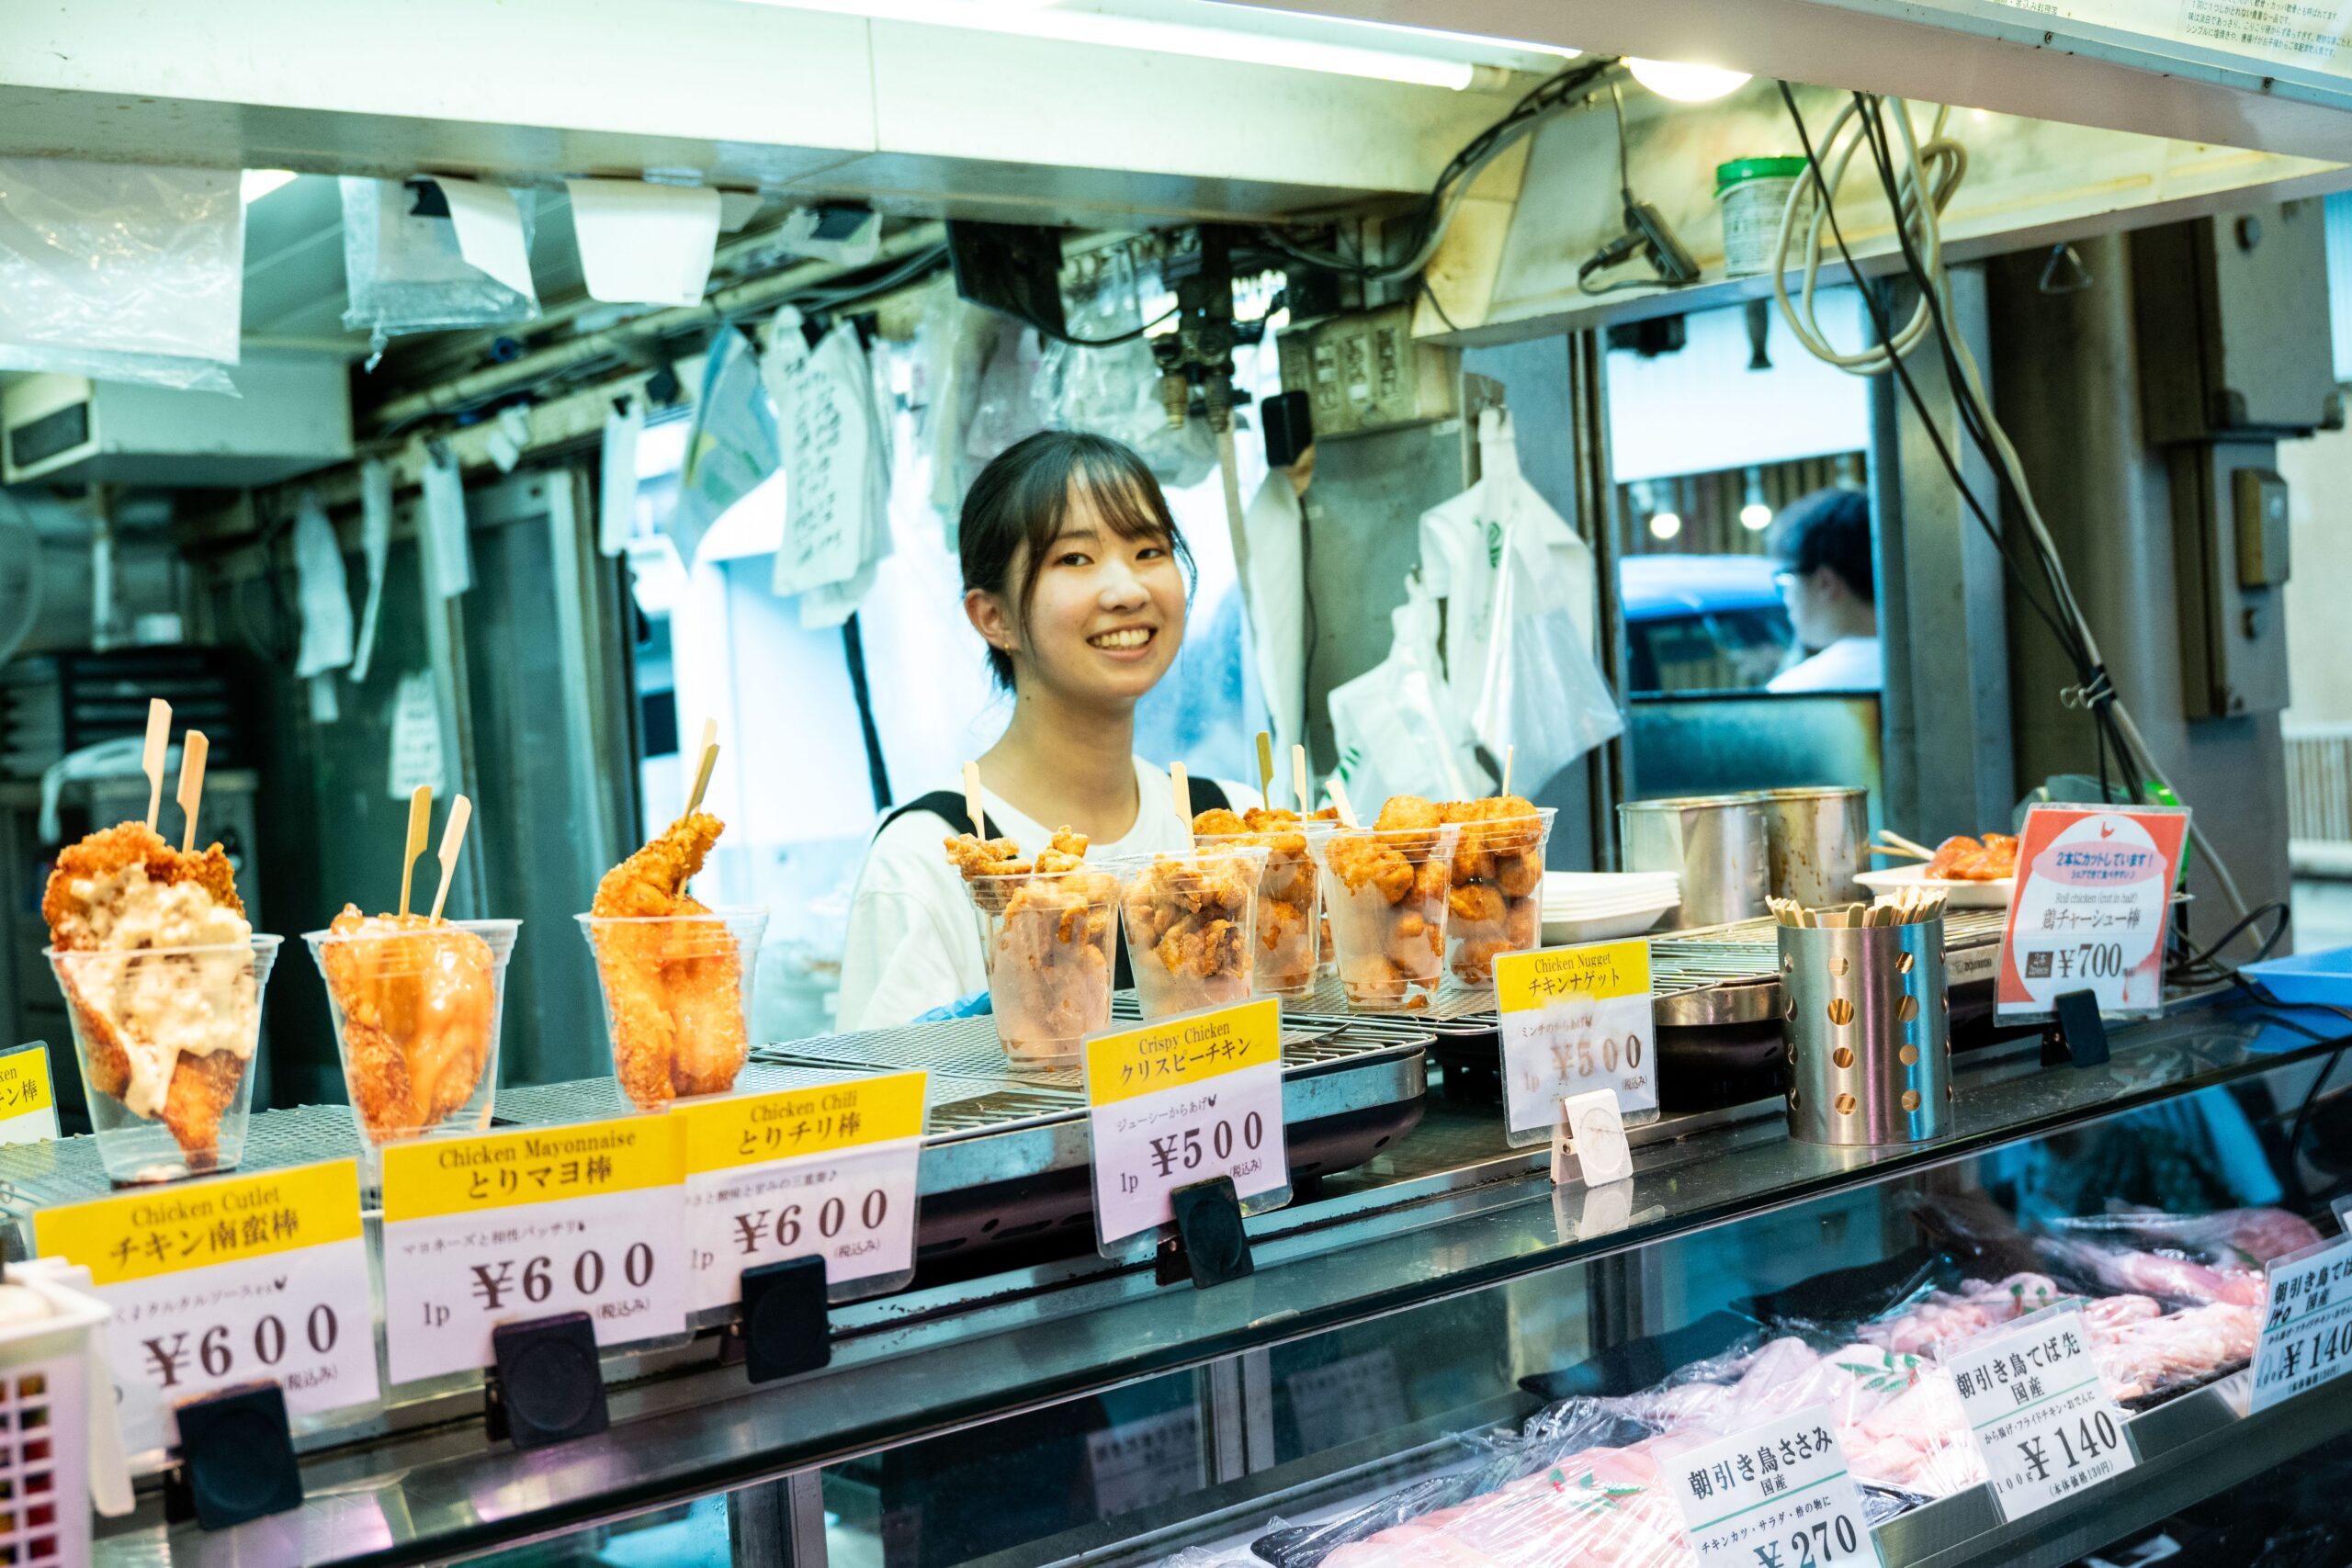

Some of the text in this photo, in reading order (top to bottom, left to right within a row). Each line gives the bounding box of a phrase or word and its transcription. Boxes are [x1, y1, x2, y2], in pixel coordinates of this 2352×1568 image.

[1529, 968, 1620, 997] チキンナゲット
[1535, 952, 1611, 974] Chicken Nugget
[2058, 942, 2121, 978] ¥700
[1139, 1021, 1230, 1055] Crispy Chicken
[1550, 1033, 1642, 1081] ¥500
[1120, 1036, 1251, 1086] クリスピーチキン
[751, 1089, 858, 1123] Chicken Chili
[439, 1130, 637, 1169] Chicken Mayonnaise
[739, 1111, 862, 1156] とりチリ棒
[1149, 1111, 1263, 1178] ¥500
[469, 1155, 613, 1200] とりマヨ棒
[1120, 1172, 1138, 1193] 1p
[131, 1185, 280, 1229] Chicken Cutlet
[733, 1189, 888, 1256] ¥600
[109, 1207, 300, 1269] チキン南蛮棒
[469, 1242, 654, 1312] ¥600
[2306, 1288, 2330, 1312] 国産
[142, 1303, 339, 1389] ¥600
[1955, 1332, 2081, 1399] 朝引き鳥てば先
[2011, 1376, 2045, 1405] 国産
[1688, 1427, 1833, 1500] 朝引き鳥ささみ
[2018, 1410, 2118, 1481] ¥140
[1760, 1473, 1789, 1496] 国産
[1702, 1495, 1831, 1555] チキンカツ・サラダ・酢の物に
